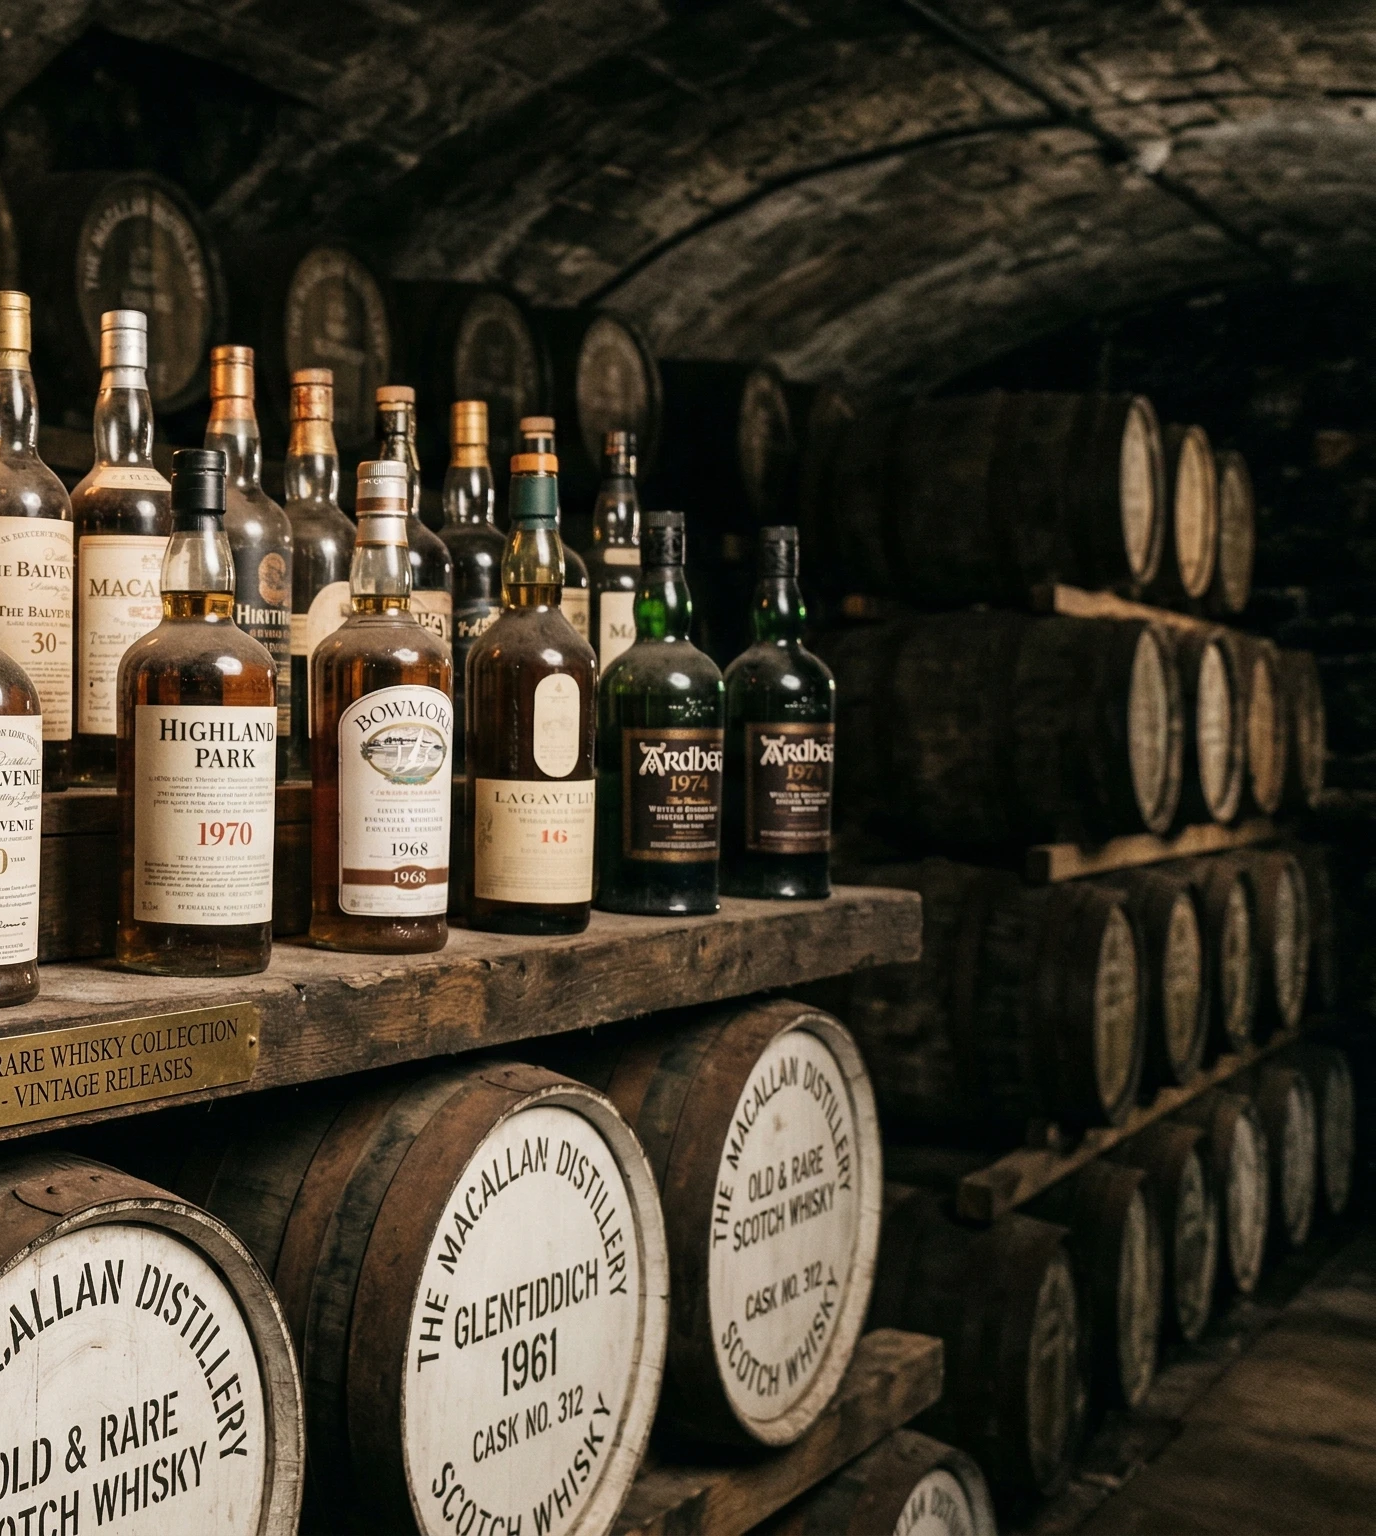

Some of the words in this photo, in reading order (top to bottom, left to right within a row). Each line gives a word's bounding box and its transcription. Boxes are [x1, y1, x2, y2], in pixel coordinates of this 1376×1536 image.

[31, 632, 57, 655] 30
[159, 718, 274, 742] HIGHLAND
[353, 700, 454, 735] BOWMORE
[194, 748, 256, 769] PARK
[669, 774, 710, 793] 1974
[196, 821, 253, 846] 1970
[391, 842, 429, 857] 1968
[540, 829, 568, 844] 16
[393, 871, 427, 884] 1968
[50, 1035, 127, 1069] WHISKY
[131, 1017, 240, 1056] COLLECTION
[14, 1072, 101, 1109] VINTAGE
[105, 1056, 193, 1093] RELEASES
[713, 1181, 733, 1249] THE
[727, 1056, 798, 1171] MACALLAN
[803, 1060, 852, 1193] DISTILLERY
[748, 1167, 775, 1204] OLD
[778, 1161, 788, 1191] &
[792, 1144, 824, 1187] RARE
[733, 1202, 785, 1252] SCOTCH
[789, 1181, 835, 1227] WHISKY
[417, 1288, 450, 1373] THE
[437, 1136, 548, 1275] MACALLAN
[557, 1140, 628, 1297] DISTILLERY
[454, 1257, 599, 1350] GLENFIDDICH
[745, 1285, 778, 1322] CASK
[781, 1277, 799, 1305] NO.
[803, 1260, 822, 1293] 312
[722, 1320, 780, 1397] SCOTCH
[786, 1265, 839, 1388] WHISKY
[136, 1264, 248, 1460] DISTILLERY
[501, 1327, 558, 1397] 1961
[64, 1425, 88, 1475] &
[99, 1390, 180, 1462] RARE
[473, 1412, 519, 1463] CASK
[525, 1400, 552, 1441] NO.
[558, 1384, 584, 1425] 312
[92, 1441, 208, 1527] WHISKY
[432, 1461, 522, 1536] SCOTCH
[533, 1391, 611, 1536] WHISKY
